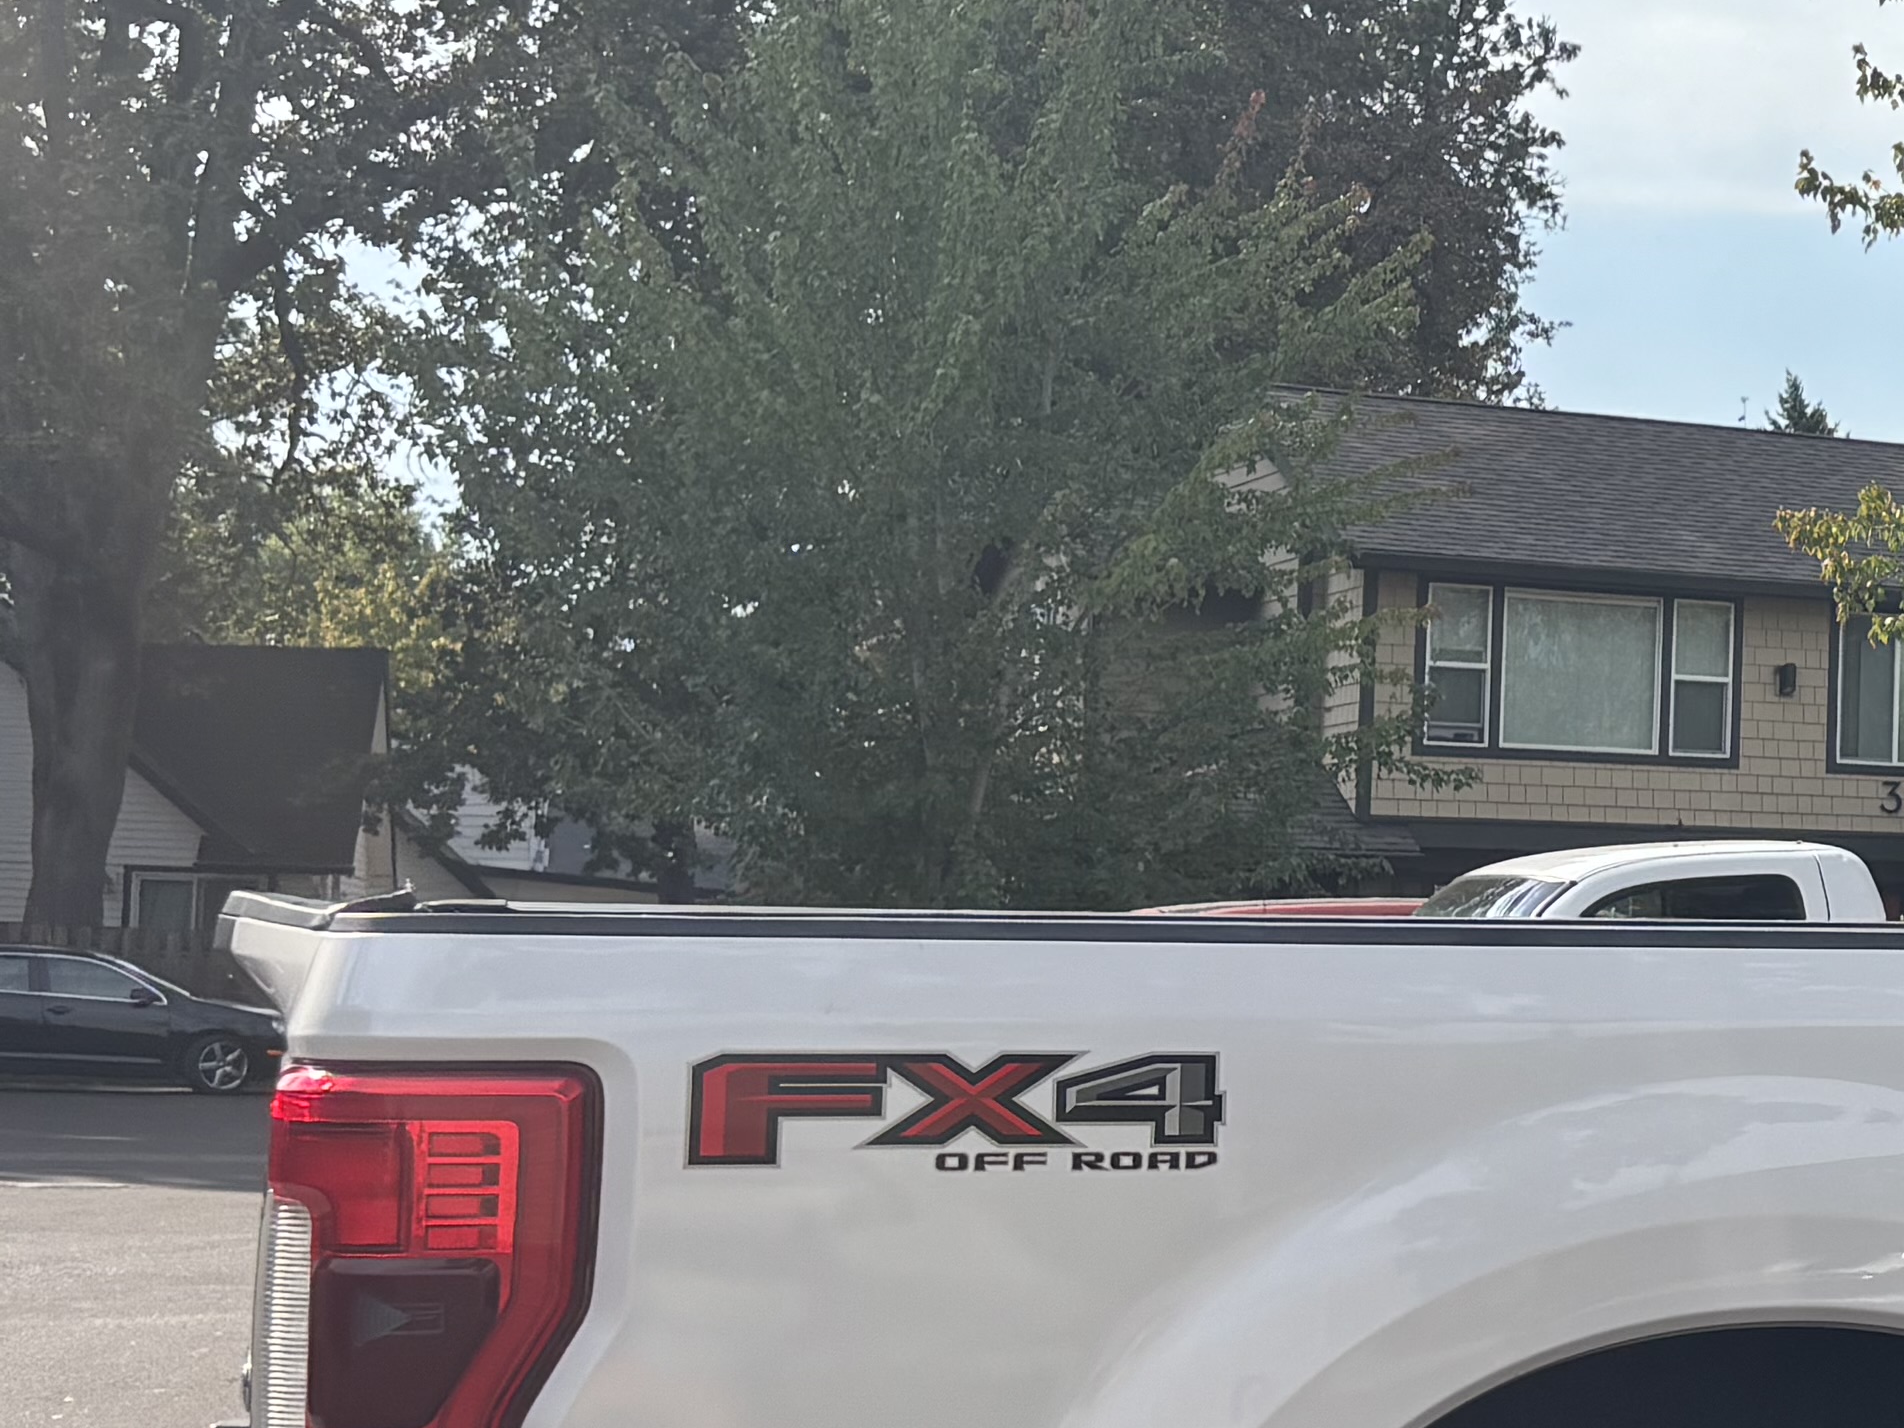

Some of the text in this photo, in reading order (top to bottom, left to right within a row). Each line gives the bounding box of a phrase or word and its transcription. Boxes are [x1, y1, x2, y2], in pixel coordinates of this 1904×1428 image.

[1880, 781, 1902, 813] 3
[684, 1050, 1226, 1168] FX4
[935, 1151, 1218, 1172] OFF ROAD
